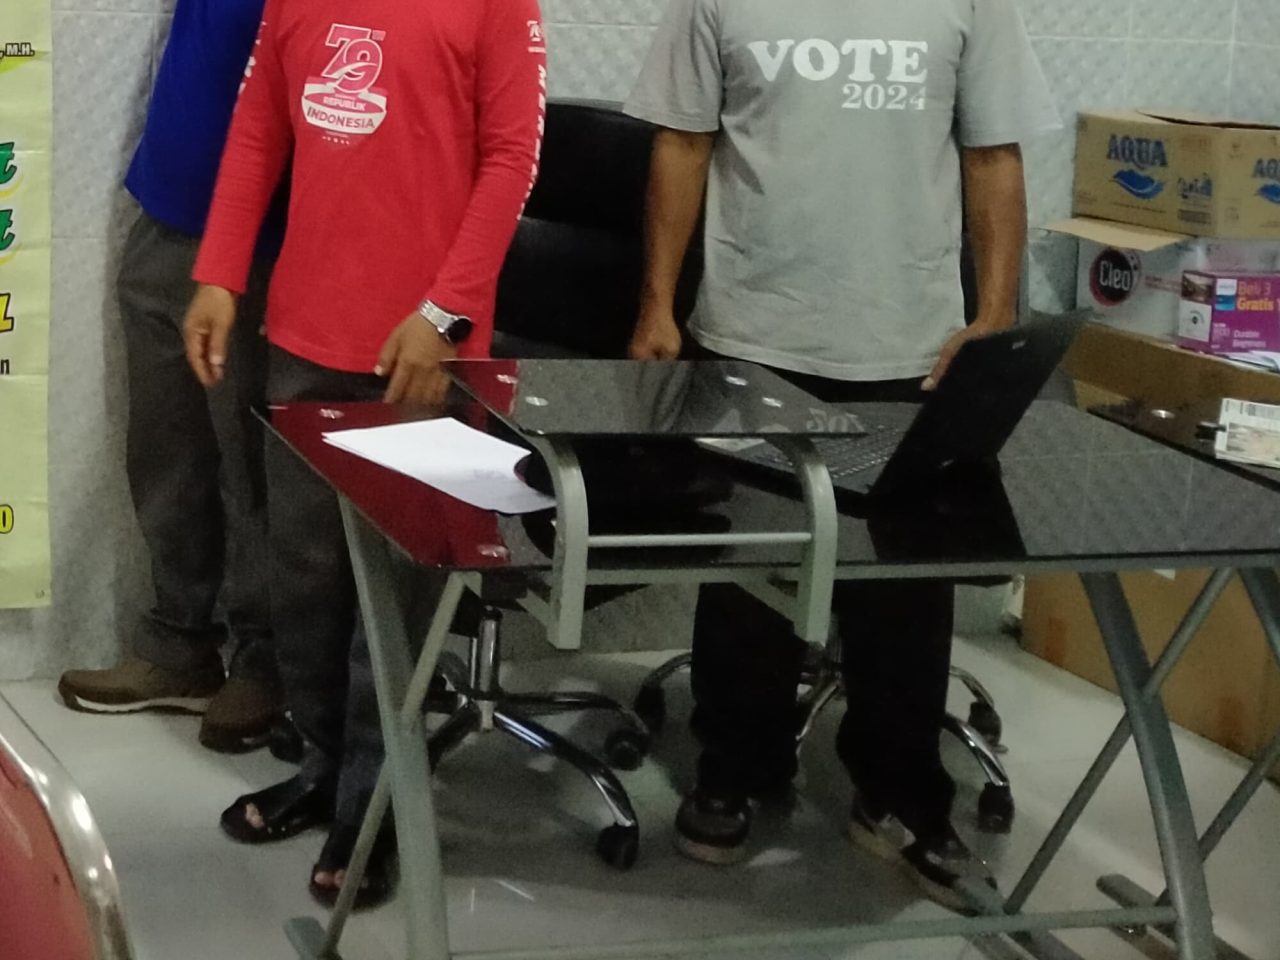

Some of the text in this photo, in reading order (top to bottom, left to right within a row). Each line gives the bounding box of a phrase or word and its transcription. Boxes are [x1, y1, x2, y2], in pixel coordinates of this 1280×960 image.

[6, 42, 35, 57] M.H.
[747, 38, 928, 83] VOTE
[841, 82, 926, 110] 2024
[306, 106, 376, 129] INDONESIA
[1106, 133, 1168, 170] AQUA
[1099, 260, 1131, 291] Cleo
